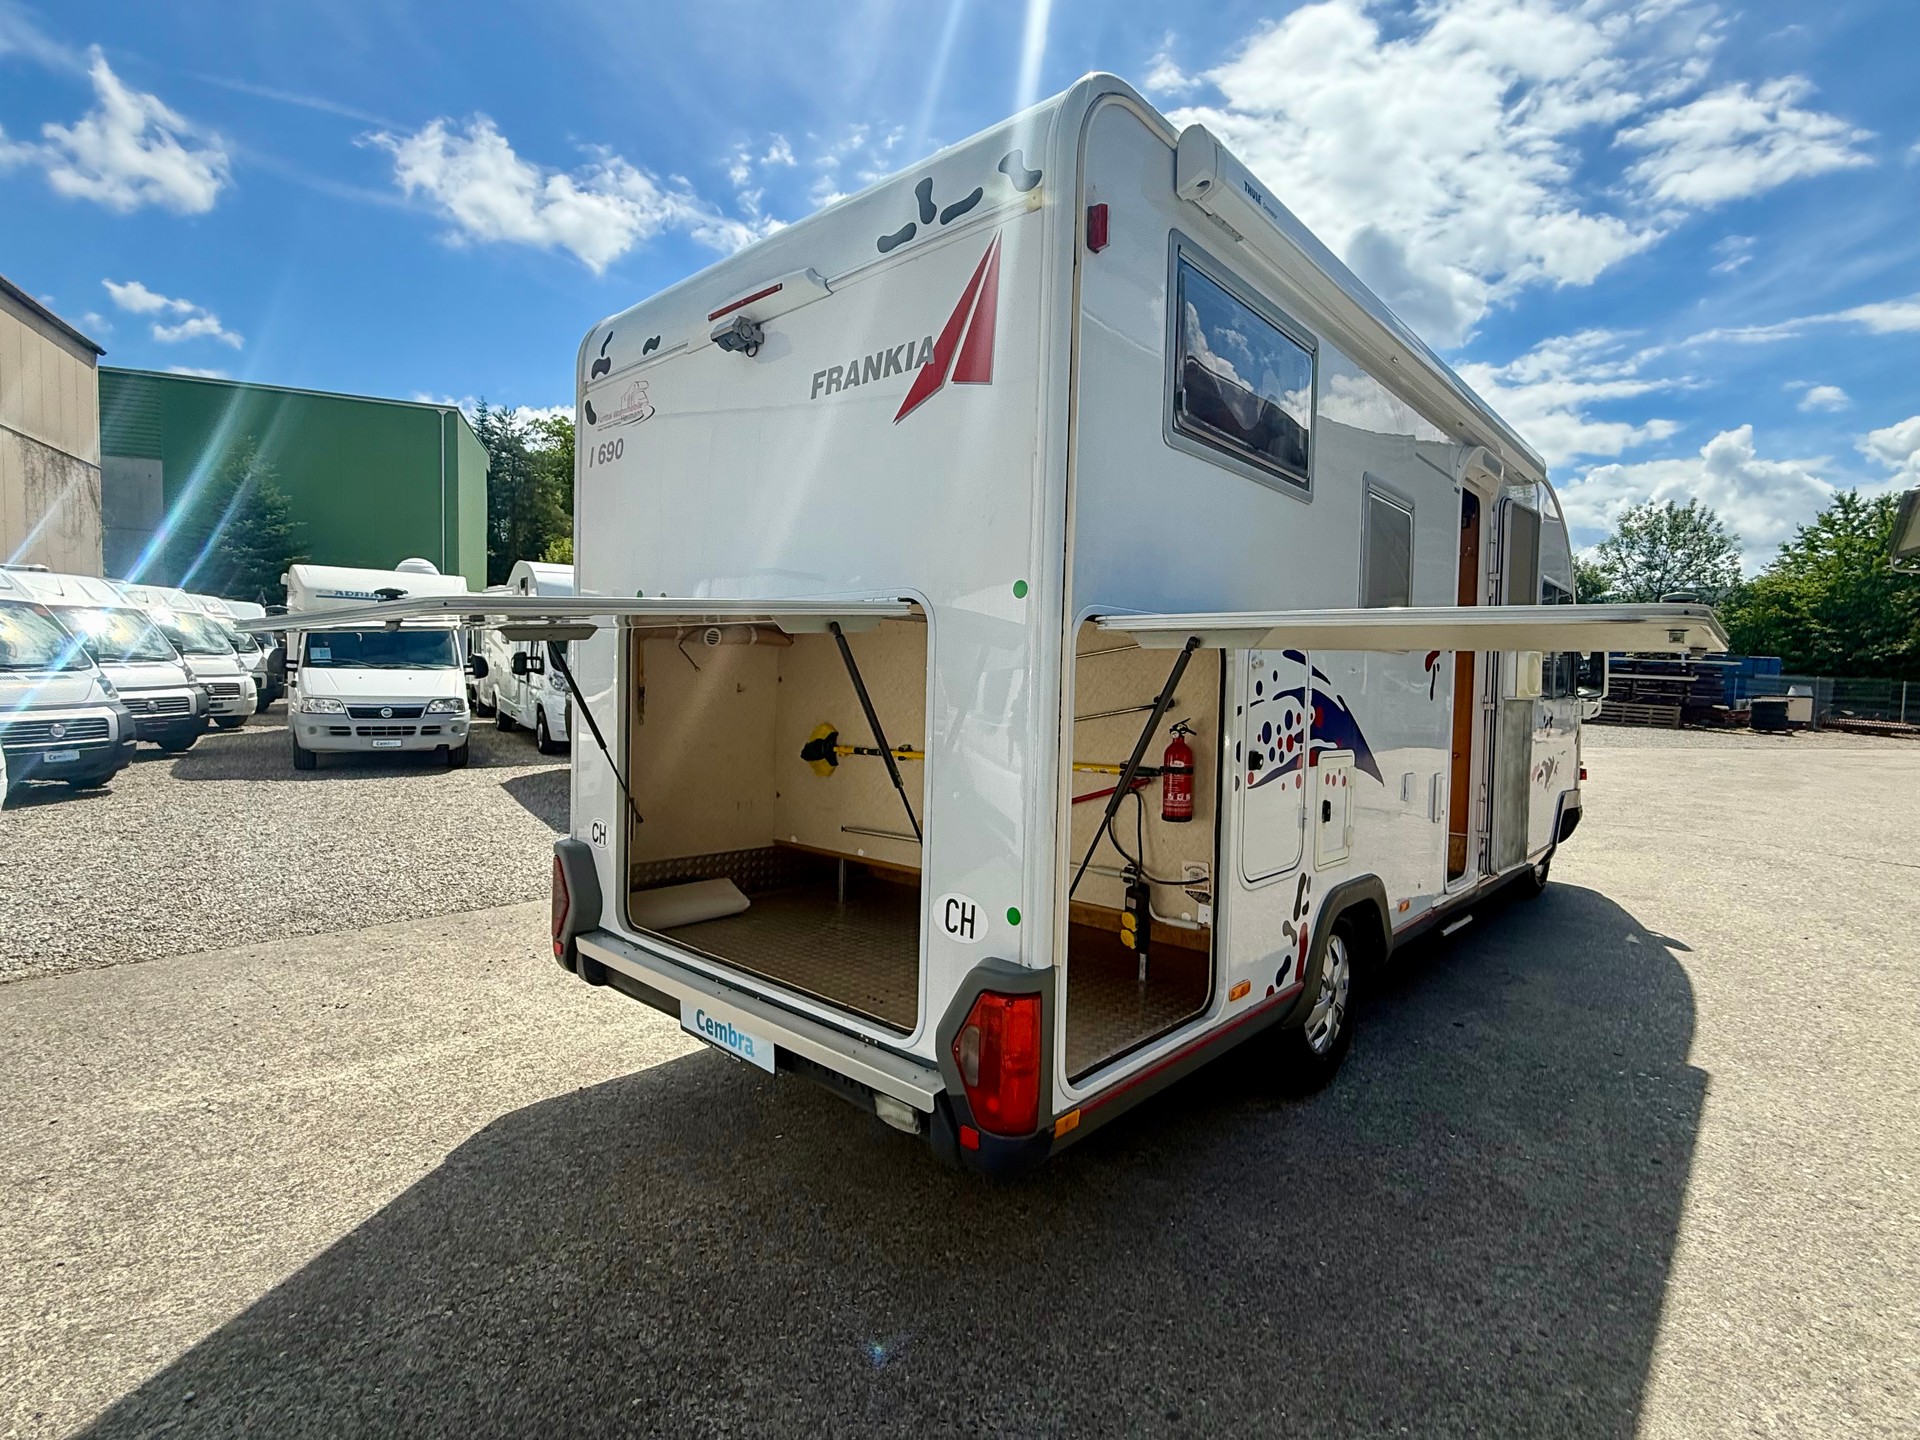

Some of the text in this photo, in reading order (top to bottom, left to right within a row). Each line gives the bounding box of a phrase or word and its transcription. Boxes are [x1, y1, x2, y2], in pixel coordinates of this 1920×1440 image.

[1244, 180, 1261, 205] THULE
[810, 335, 935, 400] FRANKIA
[598, 437, 624, 465] 690
[592, 822, 607, 846] CH
[945, 898, 976, 940] CH
[696, 1008, 755, 1058] Cembra
